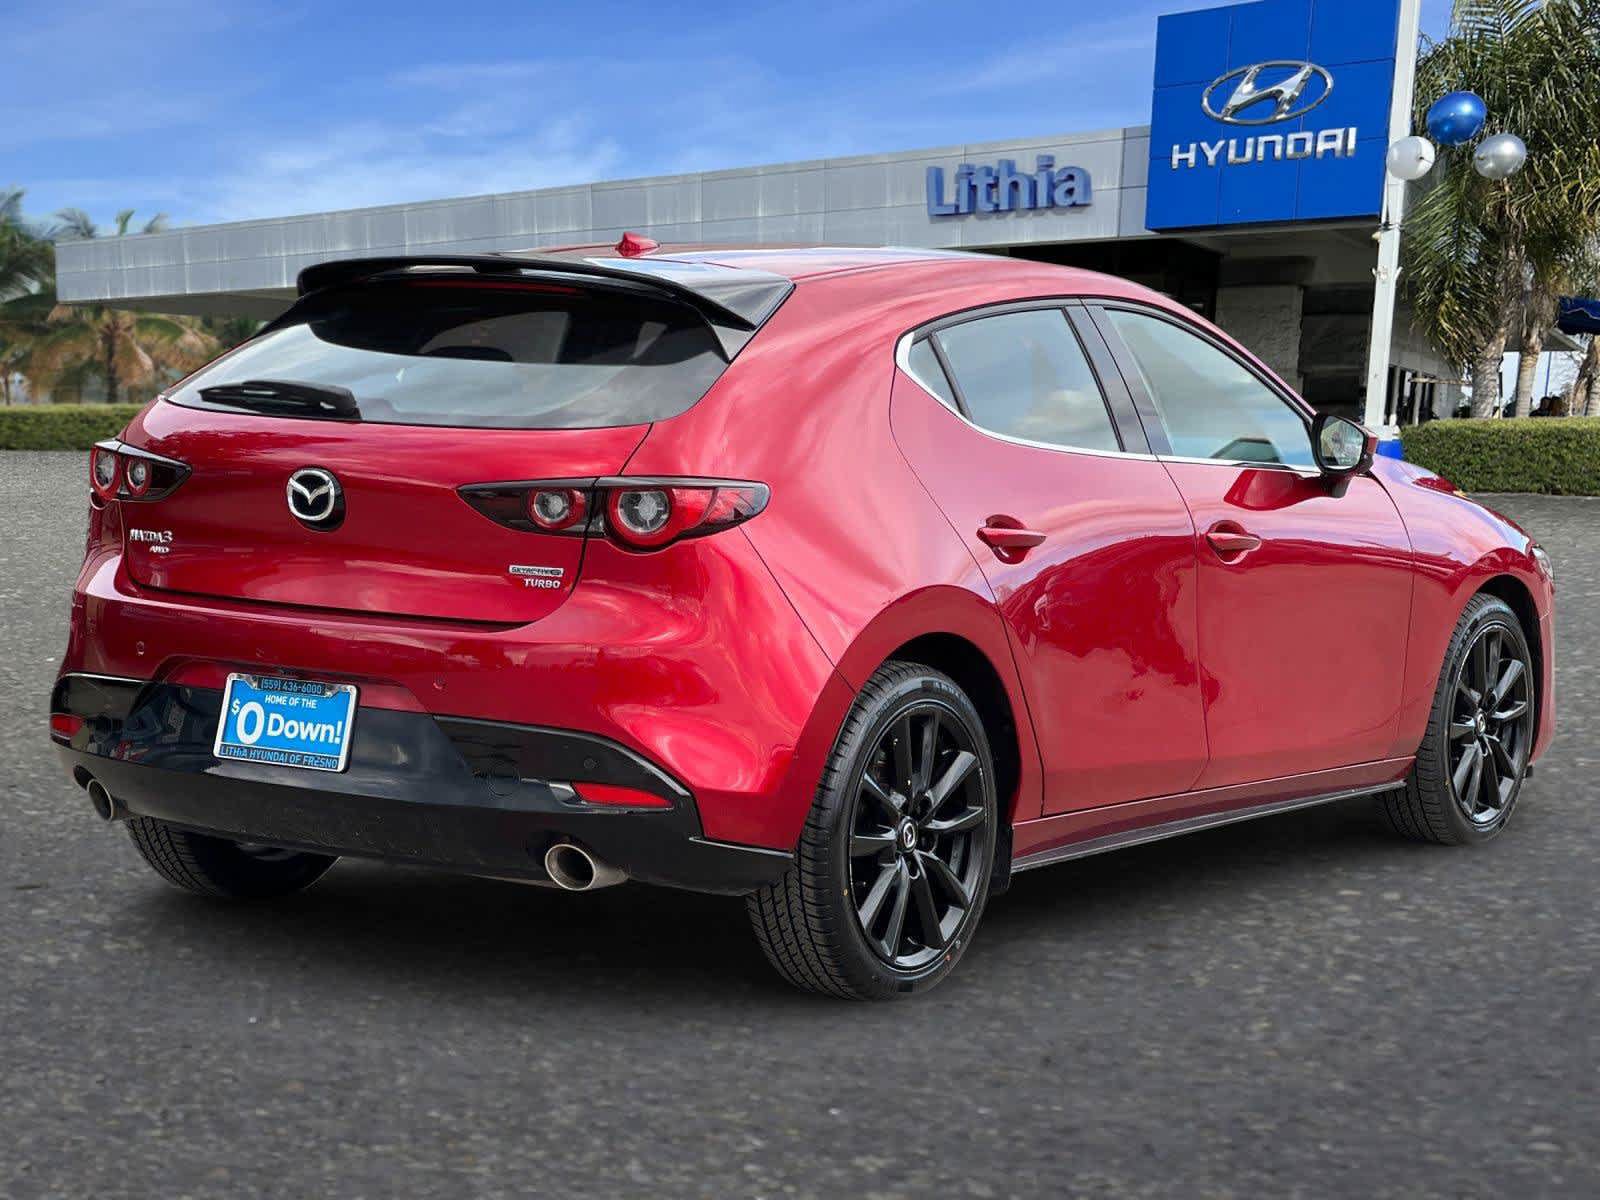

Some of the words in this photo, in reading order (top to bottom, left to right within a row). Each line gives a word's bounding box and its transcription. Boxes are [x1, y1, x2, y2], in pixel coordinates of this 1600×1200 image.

[1171, 127, 1358, 169] HYUNDAI
[926, 155, 1093, 216] Lithia
[524, 578, 561, 589] TURBO
[260, 678, 281, 690] (559)
[283, 679, 322, 694] 436-6000
[264, 694, 287, 705] HOME
[288, 696, 301, 707] OF
[301, 698, 317, 709] THE
[266, 712, 342, 744] Down!
[220, 745, 248, 759] LITHIA
[249, 749, 288, 763] HYUNDAI
[289, 754, 302, 764] OF
[303, 755, 338, 769] FRESNO
